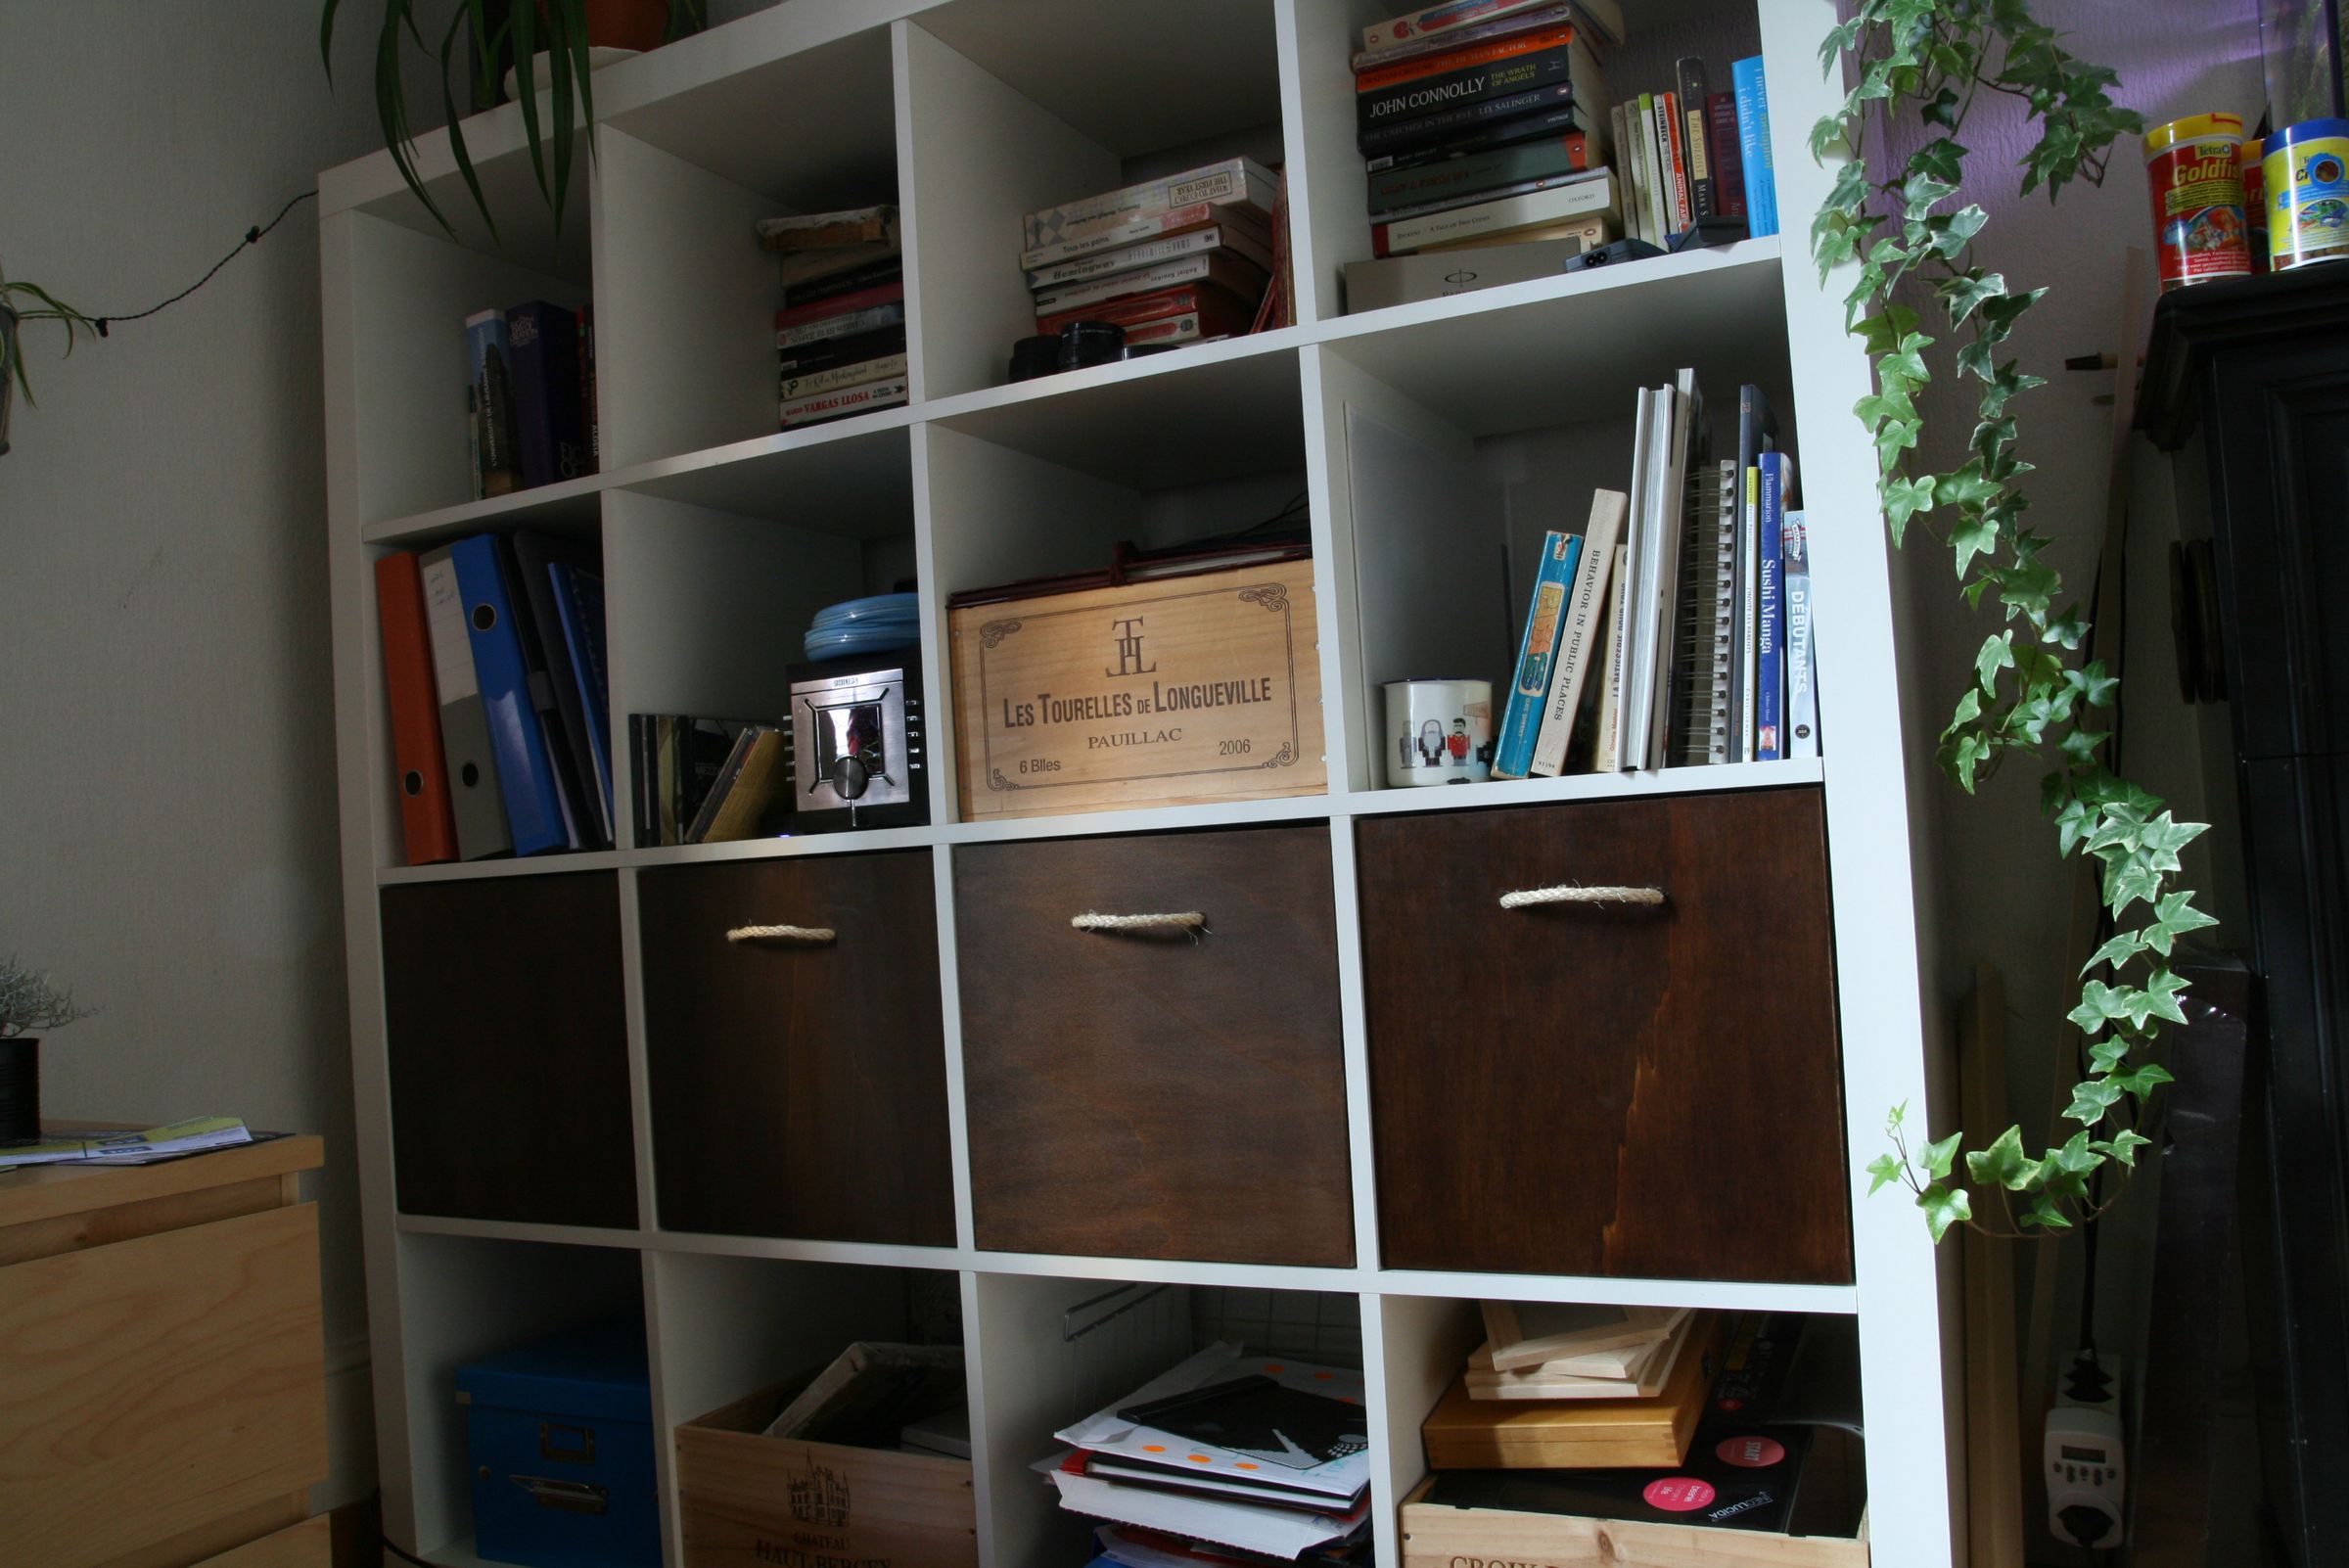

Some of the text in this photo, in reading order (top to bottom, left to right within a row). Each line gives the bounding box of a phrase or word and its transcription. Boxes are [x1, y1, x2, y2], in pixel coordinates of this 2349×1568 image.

[1491, 64, 1537, 79] THE WRATH
[1500, 70, 1535, 84] ANGELS
[1367, 76, 1487, 117] JOHN CONNOLLY
[1754, 75, 1766, 110] never
[1363, 131, 1381, 142] THE
[1382, 121, 1422, 137] CATCHER
[1424, 118, 1436, 127] IN
[1437, 115, 1452, 124] THE
[1454, 110, 1472, 119] RYE
[1495, 94, 1540, 111] SALINGER
[1546, 114, 1569, 123] VINTAGE
[1737, 94, 1754, 129] didn't
[1656, 105, 1668, 142] STEINBECK
[1689, 115, 1706, 173] THE SOLOIST
[1742, 133, 1757, 158] like
[2198, 146, 2223, 156] Tetra
[2173, 159, 2241, 186] Goldfis
[1175, 175, 1226, 194] THE FIRST YEAR
[1208, 183, 1228, 194] WHAT
[1674, 172, 1685, 201] ANIMAL
[1695, 183, 1708, 208] MARK
[1173, 191, 1199, 204] EXPECT
[1568, 193, 1595, 204] OXFORD
[1678, 203, 1687, 218] FAR
[1063, 243, 1079, 254] Tous
[1091, 236, 1109, 250] pains
[1053, 260, 1115, 280] Hemingway
[804, 396, 840, 413] VARGAS
[840, 391, 870, 405] LLOSA
[1762, 473, 1774, 523] Flammarion
[1758, 559, 1775, 654] Sushi Manga
[1552, 548, 1601, 721] BEHAVIOR IN PUBLIC PLACES
[1790, 590, 1809, 693] DÉBUTANTS
[1003, 677, 1271, 728] LES TOURELLES DE LONGUEVILLE
[1088, 728, 1182, 749] PAUILLAC
[1219, 740, 1251, 756] 2006
[1020, 759, 1061, 773] 6 Blles
[1741, 1440, 1762, 1461] START
